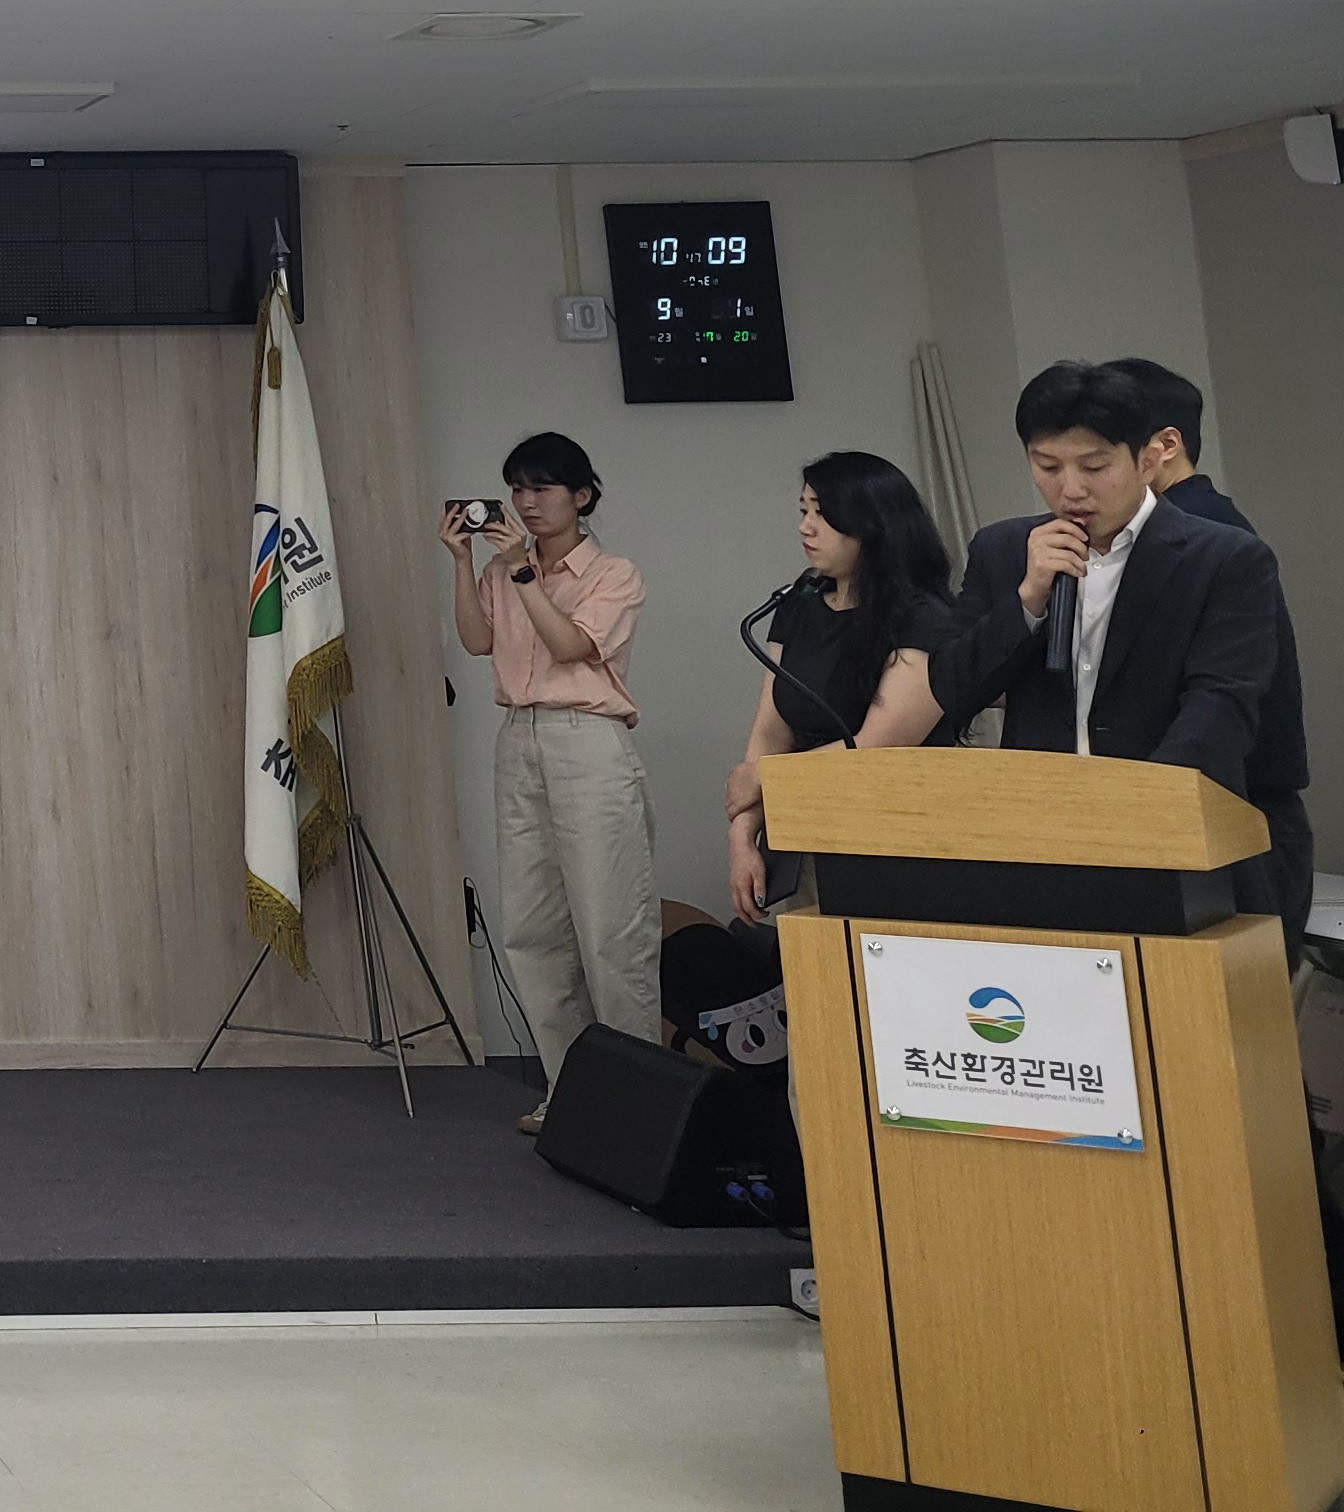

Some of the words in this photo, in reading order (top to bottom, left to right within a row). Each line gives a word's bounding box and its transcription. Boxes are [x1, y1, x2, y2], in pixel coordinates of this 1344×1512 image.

[652, 237, 678, 265] 10
[707, 236, 747, 264] 09
[286, 570, 333, 603] Institute
[903, 1047, 1104, 1094] 축산환경관리원
[906, 1079, 946, 1091] Livestock
[948, 1082, 1009, 1096] Environmental
[1011, 1088, 1068, 1102] Management
[1069, 1094, 1106, 1106] Institute
